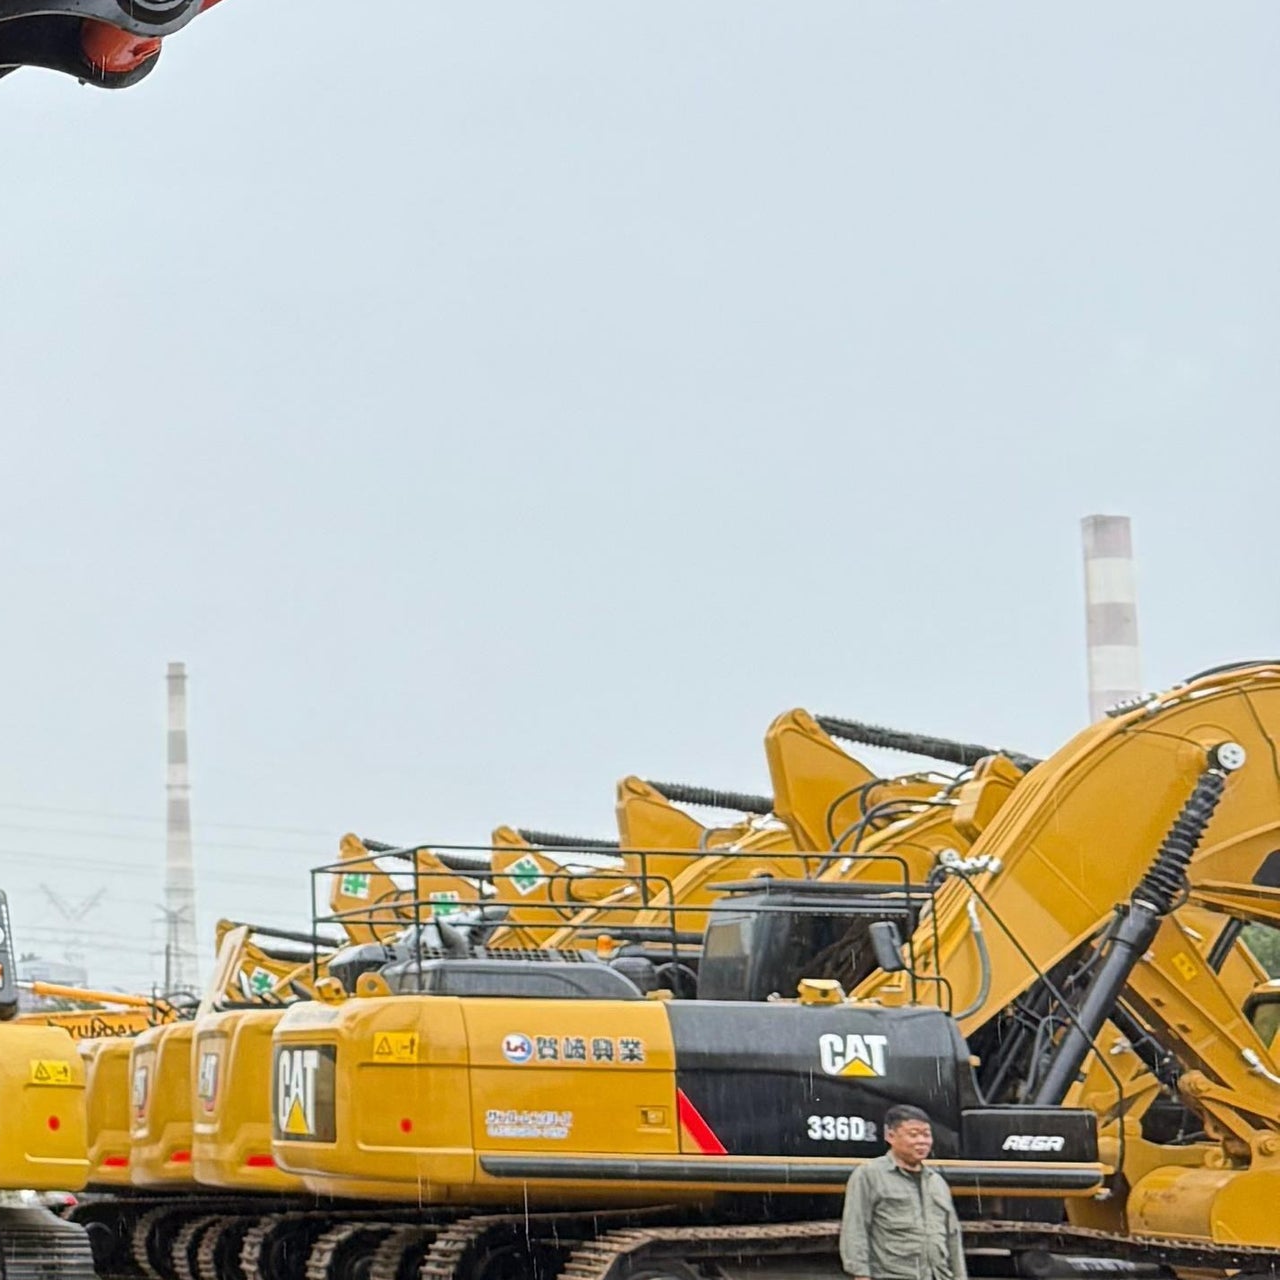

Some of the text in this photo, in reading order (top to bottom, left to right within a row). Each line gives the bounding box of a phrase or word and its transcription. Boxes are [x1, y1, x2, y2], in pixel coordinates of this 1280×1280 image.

[64, 1023, 133, 1039] YUNDAI
[818, 1033, 888, 1077] CAT
[278, 1049, 321, 1135] CAT
